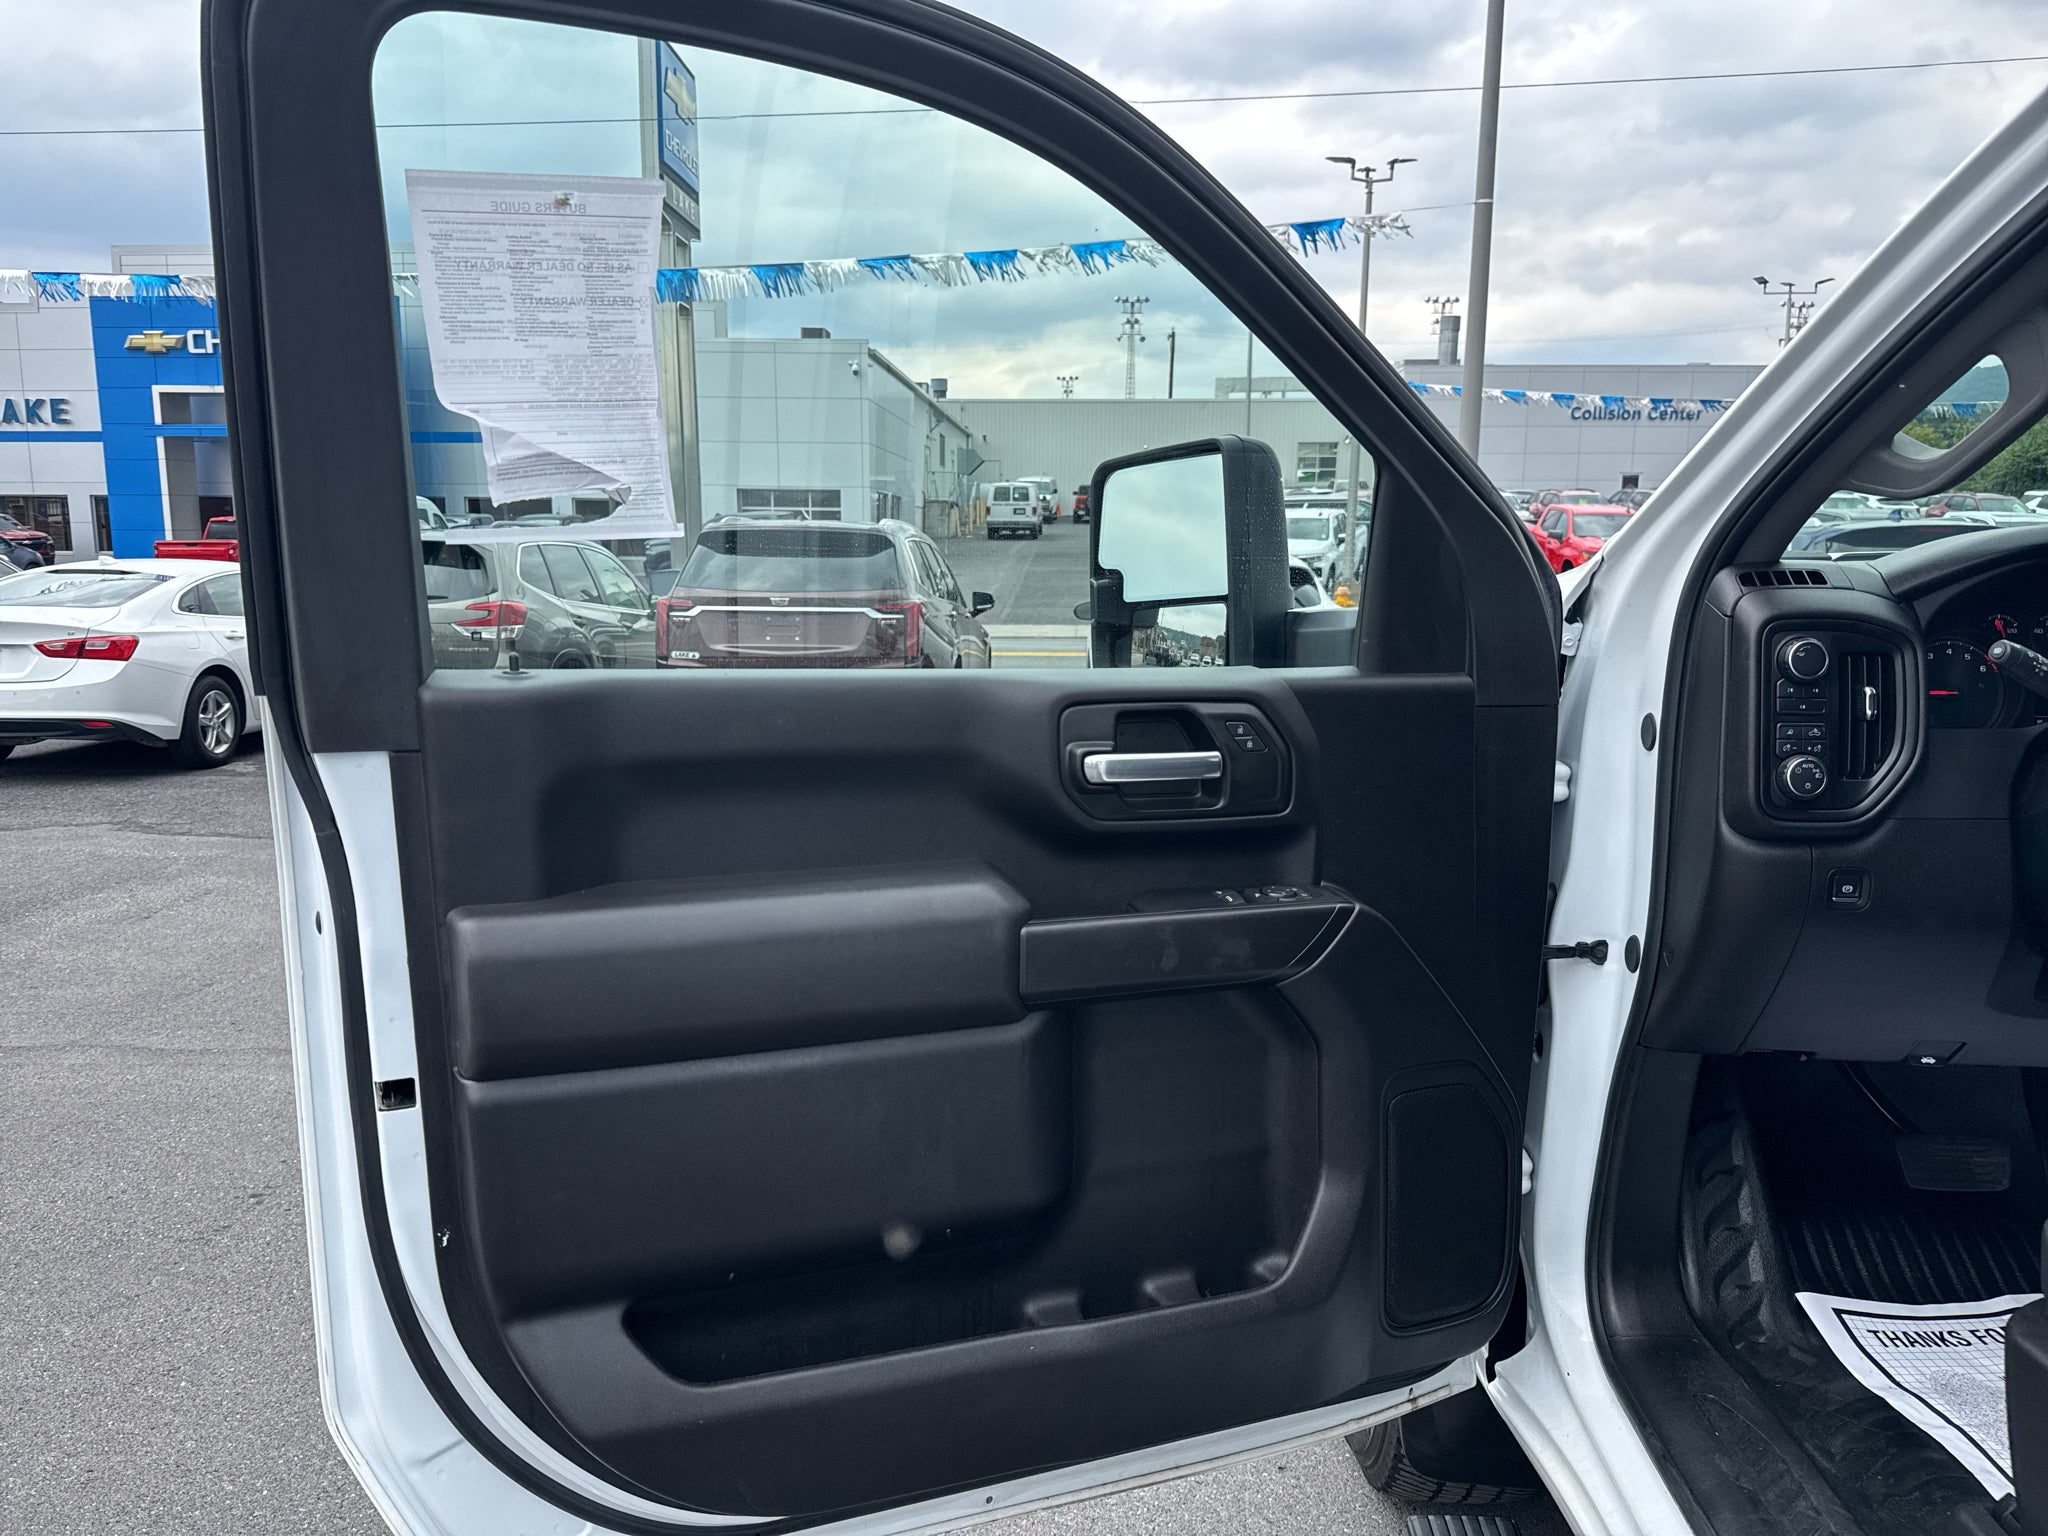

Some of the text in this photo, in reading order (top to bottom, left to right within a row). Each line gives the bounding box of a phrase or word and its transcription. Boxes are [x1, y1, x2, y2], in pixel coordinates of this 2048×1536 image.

[672, 184, 696, 220] LAKE
[1570, 406, 1703, 421] Collision Center
[1866, 1326, 2006, 1348] THANKS FO
